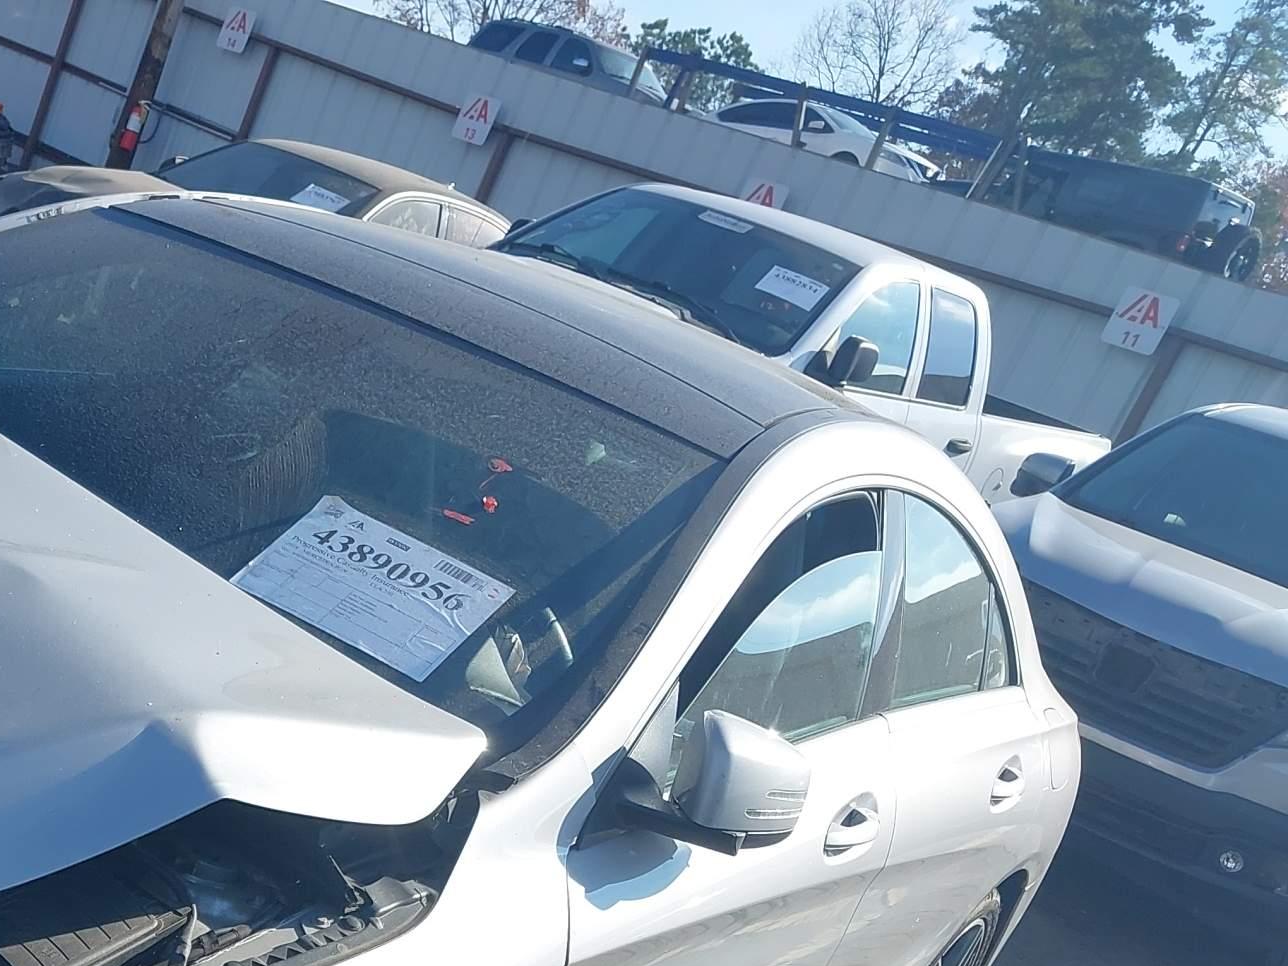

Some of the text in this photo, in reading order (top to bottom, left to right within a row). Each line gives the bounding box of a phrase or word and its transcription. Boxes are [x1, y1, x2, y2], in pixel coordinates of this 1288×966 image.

[464, 127, 477, 140] 13
[1121, 331, 1142, 348] 11
[311, 529, 472, 612] 43890956
